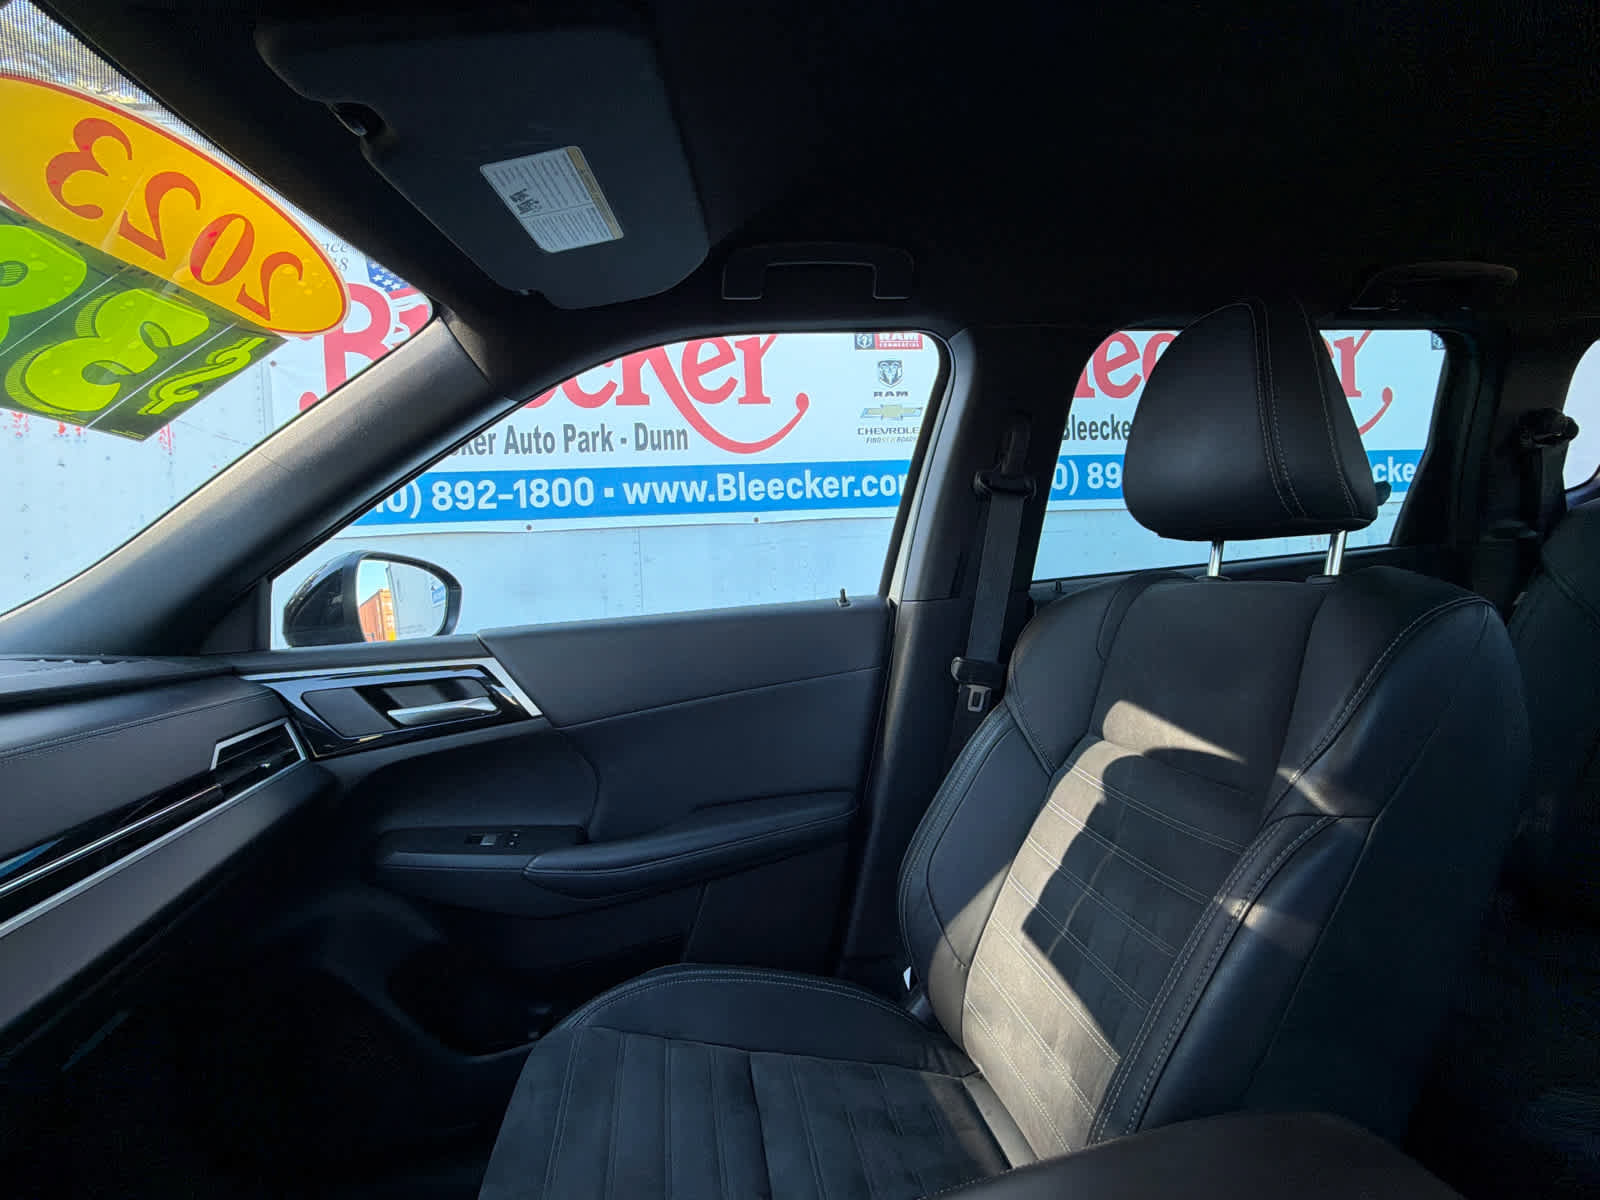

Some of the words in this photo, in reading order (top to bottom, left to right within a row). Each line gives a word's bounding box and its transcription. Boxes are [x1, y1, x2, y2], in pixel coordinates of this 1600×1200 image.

[504, 424, 556, 454] Auto
[563, 423, 614, 453] Park
[634, 422, 689, 451] Dunn
[432, 477, 594, 511] 892-1800
